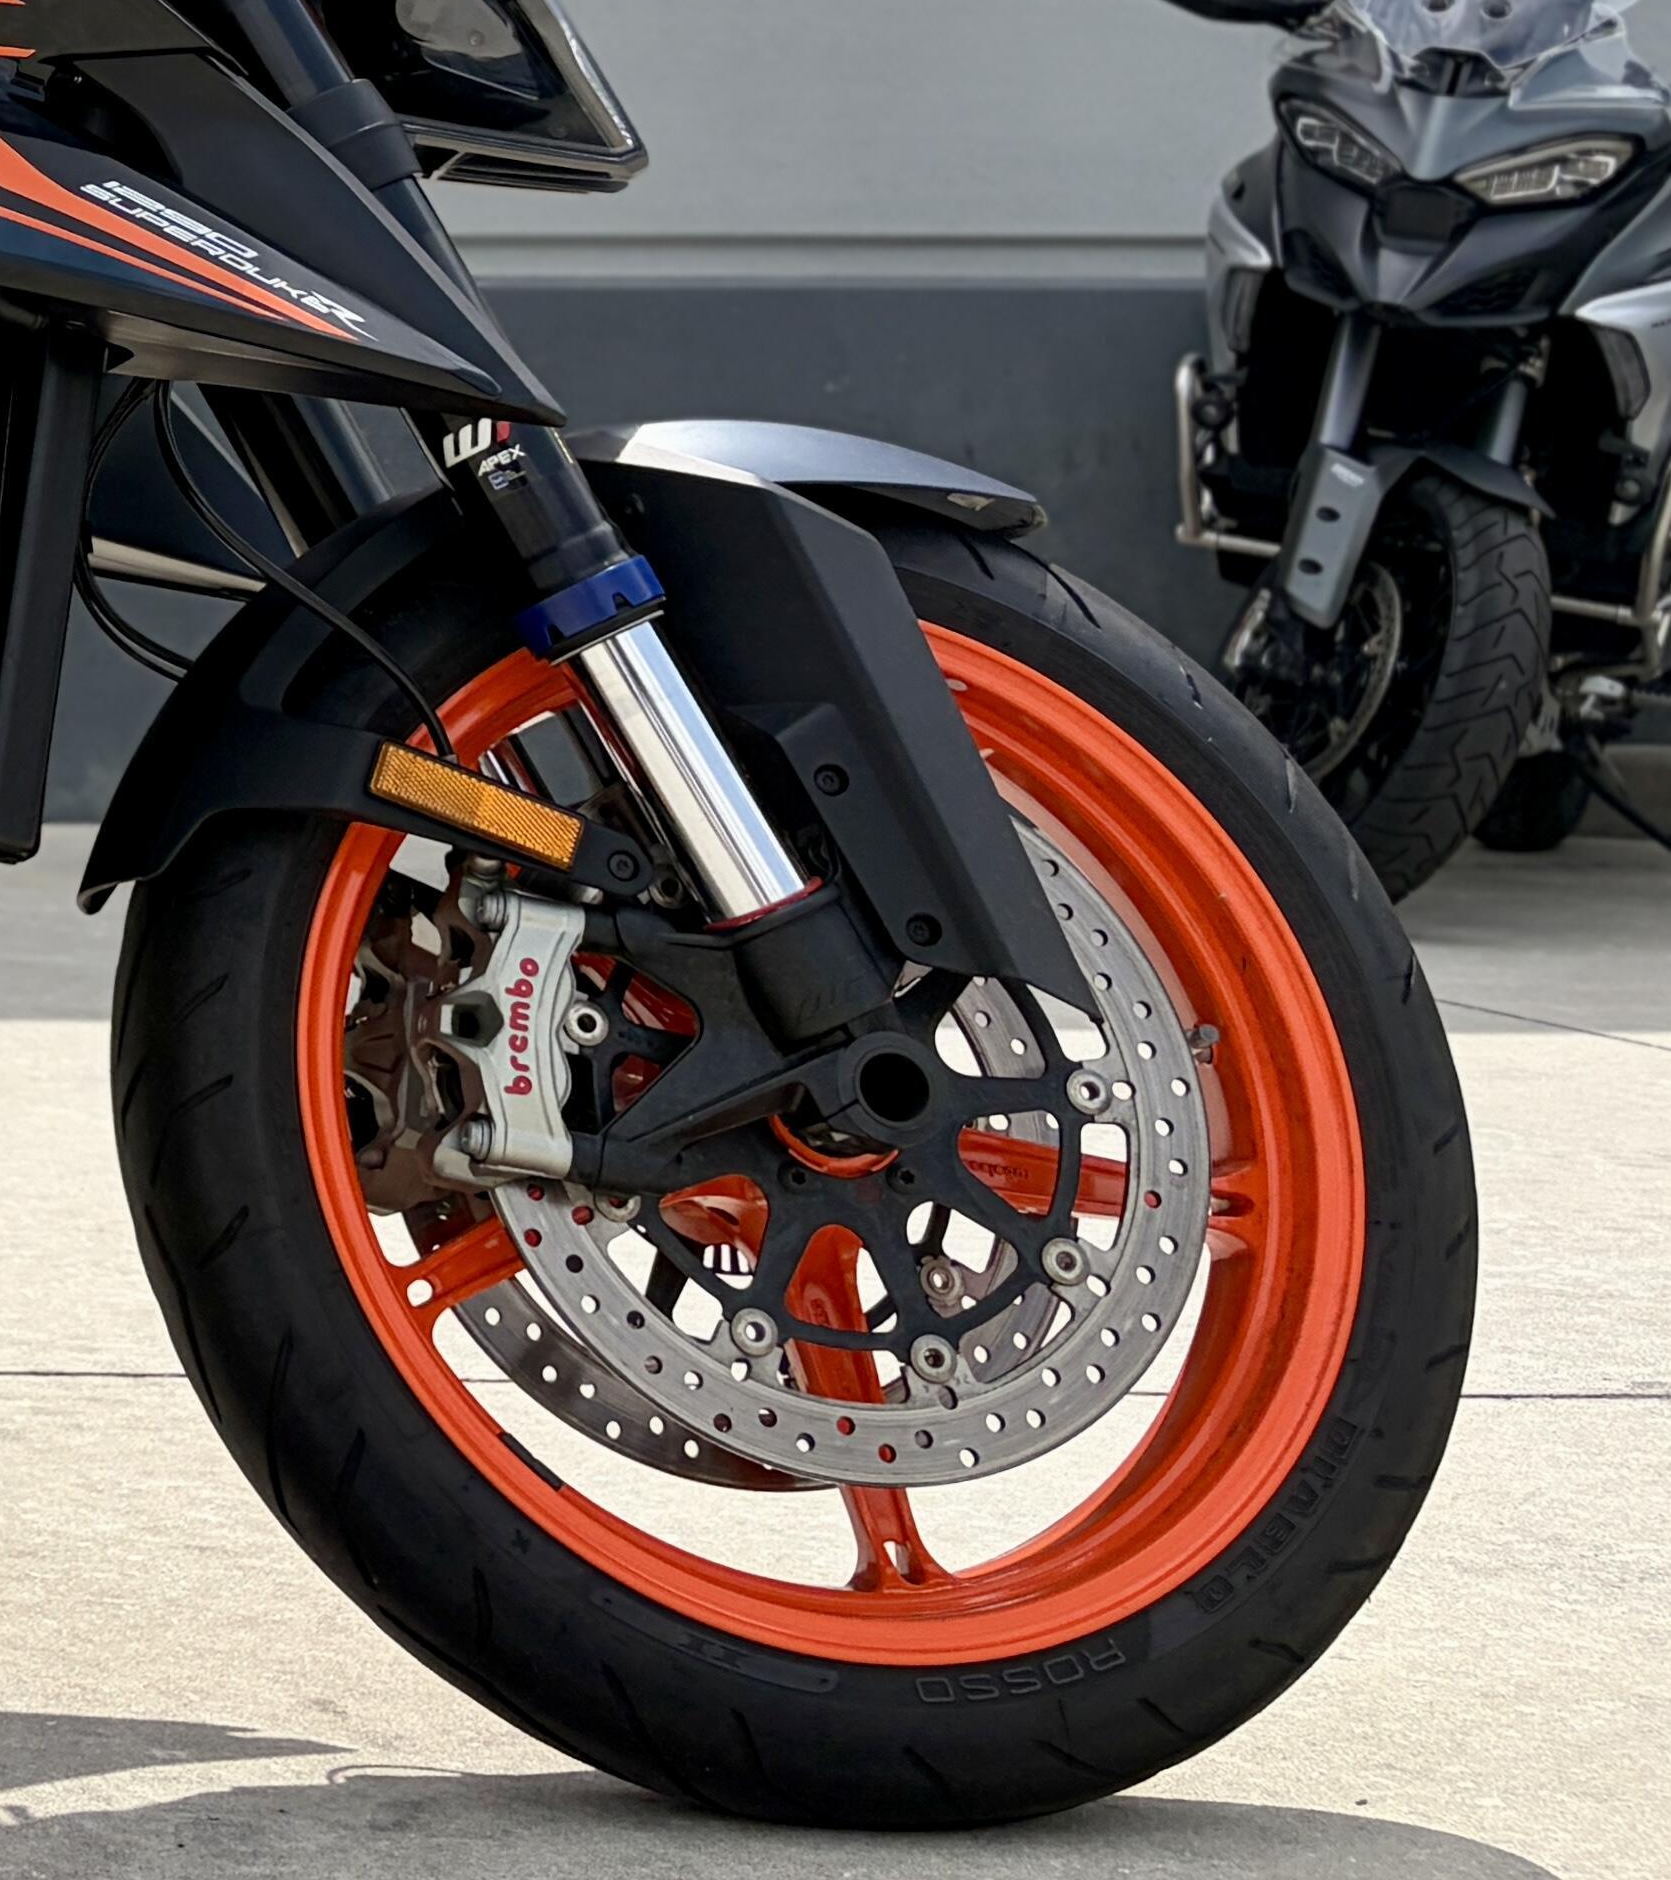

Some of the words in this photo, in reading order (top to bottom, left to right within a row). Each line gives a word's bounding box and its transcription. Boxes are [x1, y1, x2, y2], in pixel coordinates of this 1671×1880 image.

[102, 180, 258, 259] 1290
[477, 444, 526, 476] APEX
[504, 957, 541, 1097] brembo
[914, 1637, 1128, 1704] ROSSO
